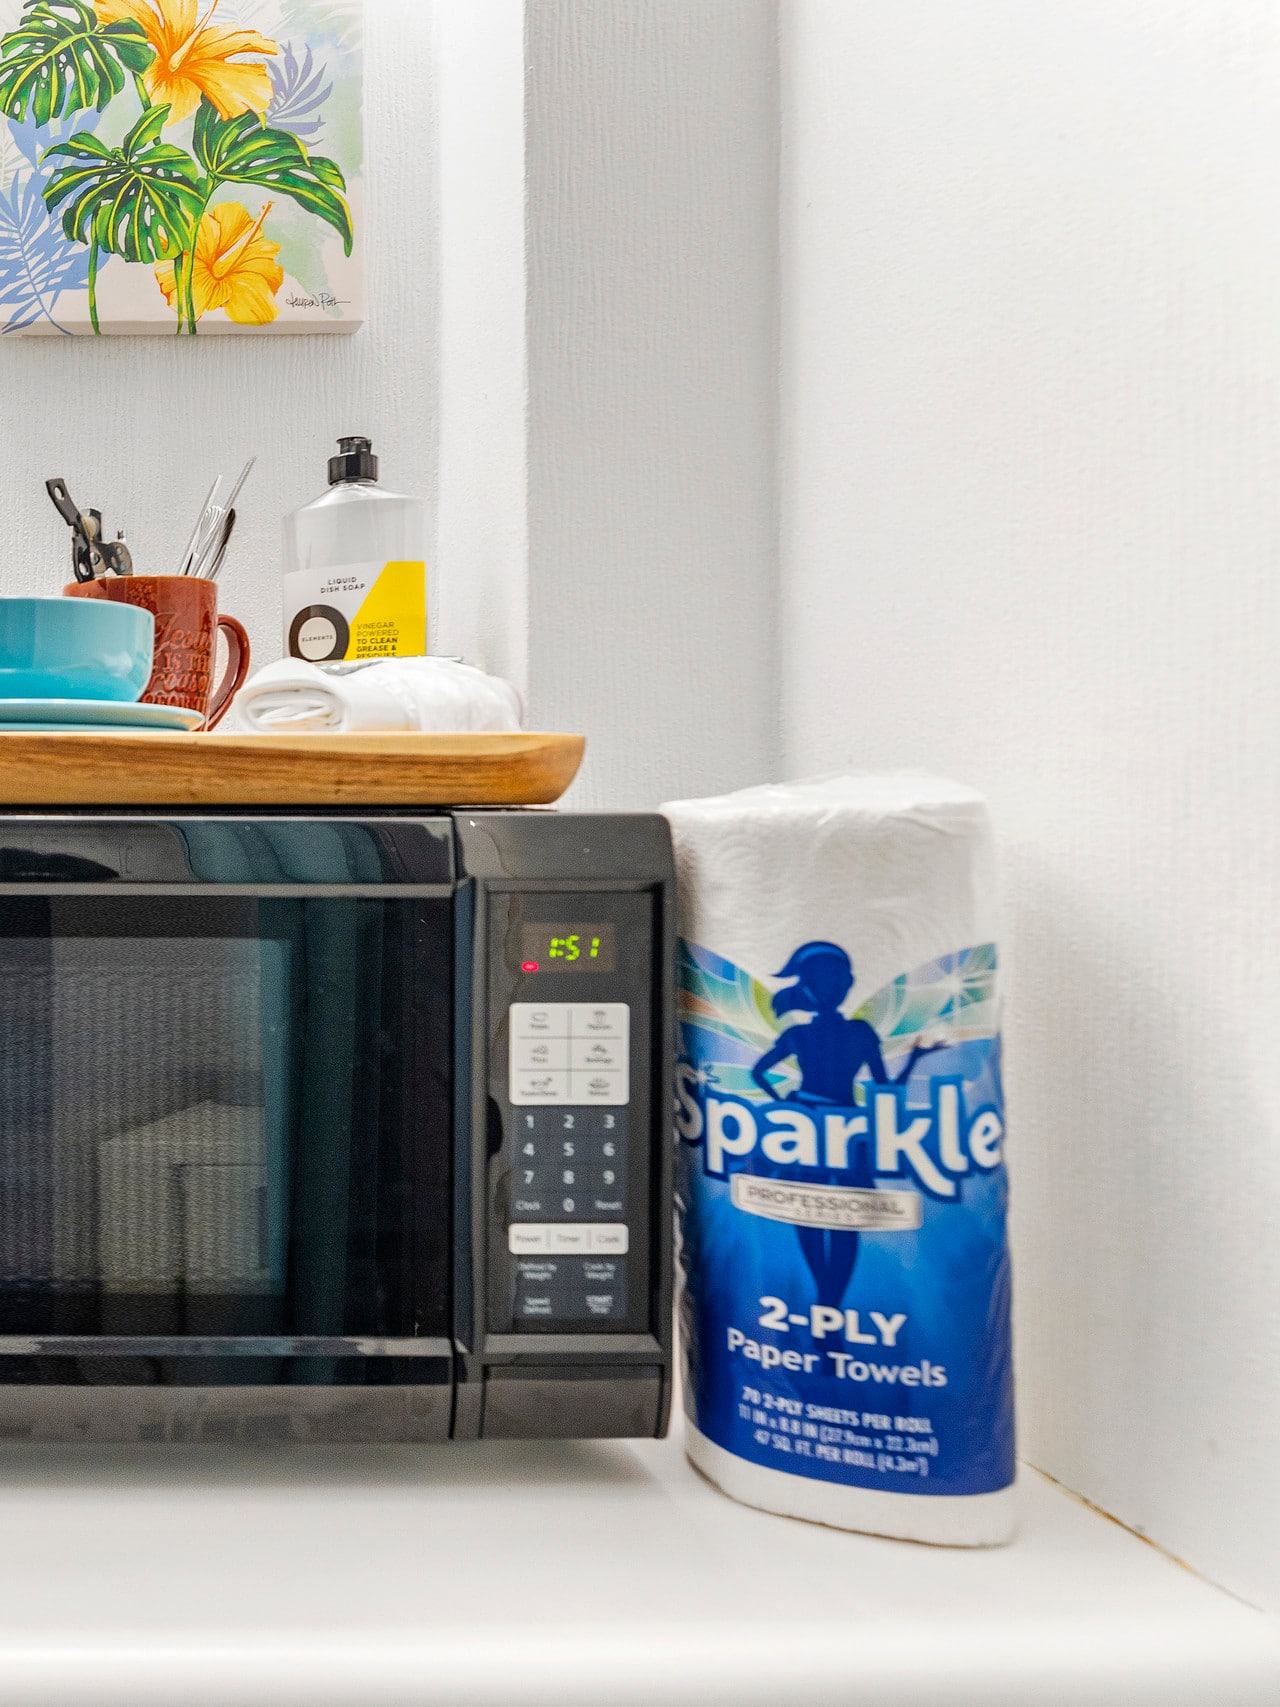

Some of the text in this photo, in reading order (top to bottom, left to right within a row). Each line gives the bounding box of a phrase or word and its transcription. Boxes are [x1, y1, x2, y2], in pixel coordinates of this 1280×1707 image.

[328, 576, 357, 585] LIQUID
[320, 583, 366, 594] DISH SOAP
[357, 621, 395, 630] VINEGAR
[357, 629, 399, 637] POWERED
[525, 1114, 535, 1129] 1
[563, 1114, 575, 1129] 2
[603, 1114, 615, 1129] 3
[677, 1062, 1002, 1198] Sparkle
[523, 1142, 535, 1156] 4
[563, 1142, 575, 1156] 5
[603, 1142, 615, 1156] 6
[524, 1170, 535, 1184] 7
[563, 1170, 575, 1184] 8
[603, 1170, 615, 1184] 9
[563, 1197, 575, 1212] 0
[747, 1185, 906, 1215] PROFESSIONAL
[758, 1295, 908, 1347] 2-PLY
[727, 1327, 948, 1388] Paper Towels
[742, 1385, 934, 1434] 70 2-PLY SHEETS PER ROLL
[815, 1443, 842, 1463] PER
